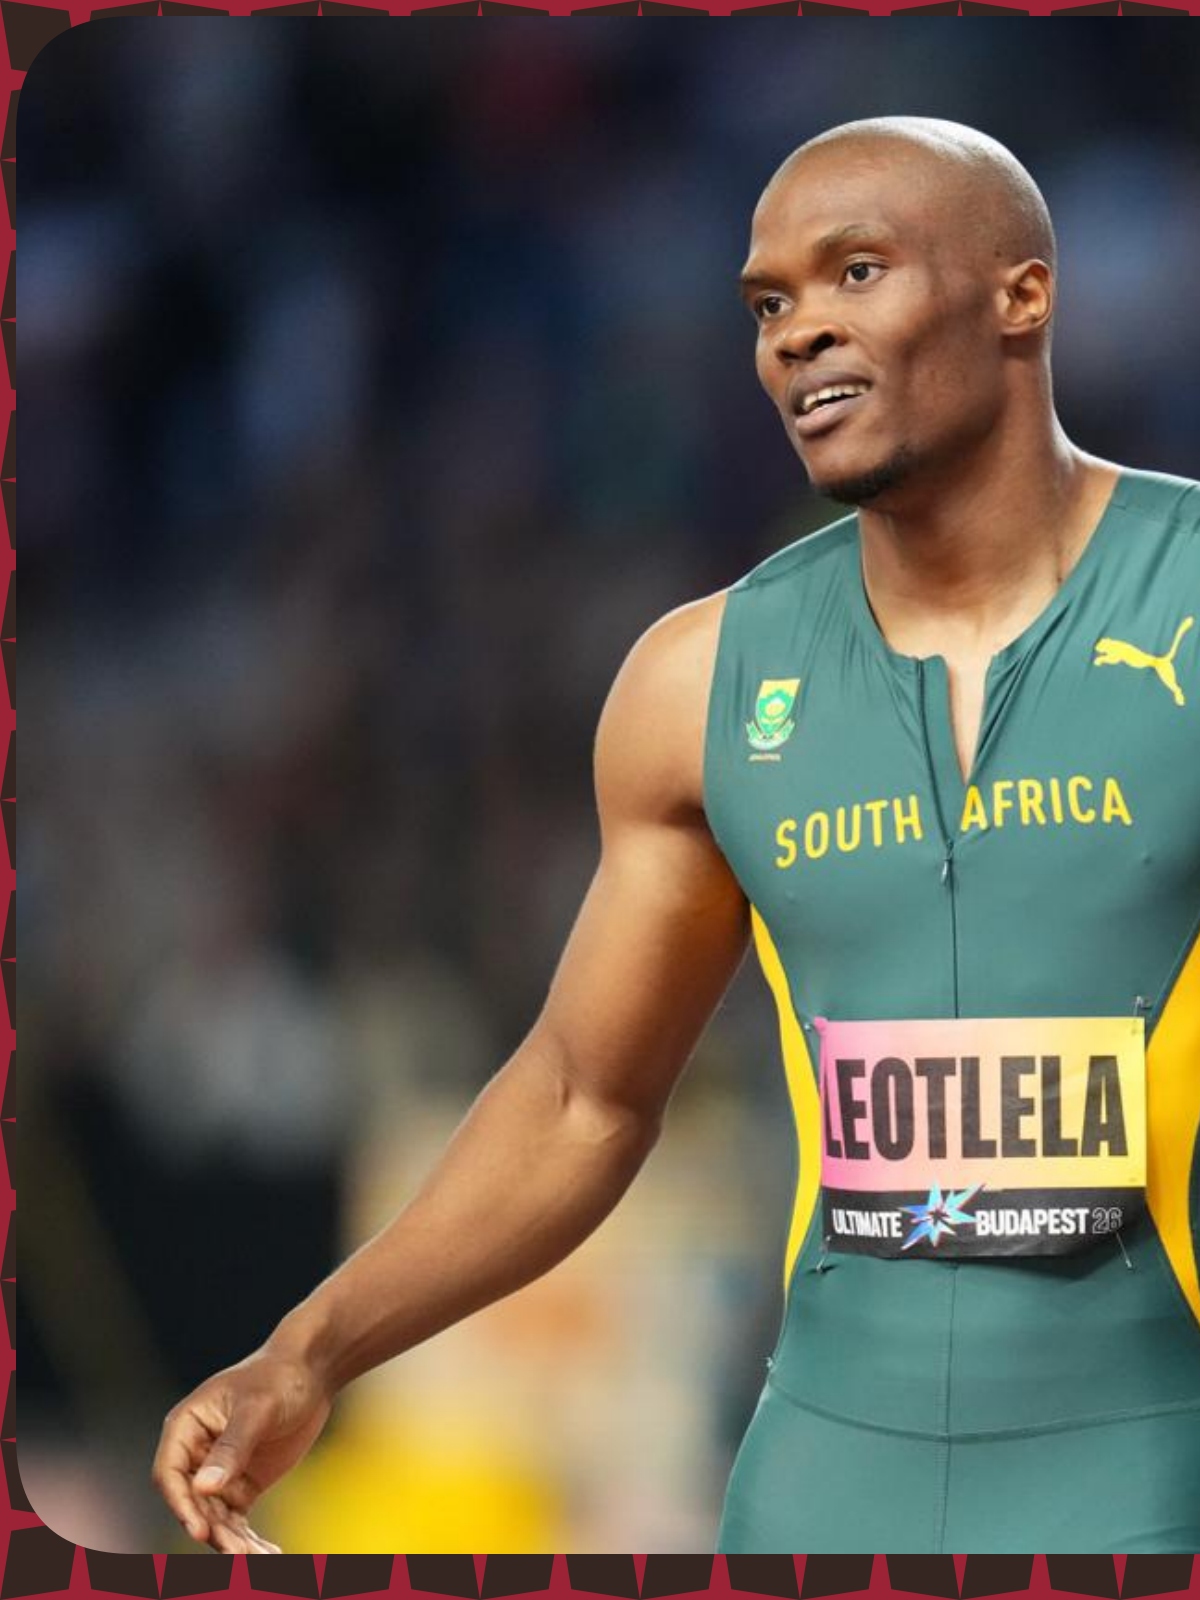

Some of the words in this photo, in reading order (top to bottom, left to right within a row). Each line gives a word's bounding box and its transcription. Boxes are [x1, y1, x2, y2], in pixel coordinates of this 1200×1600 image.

[775, 794, 923, 869] SOUTH
[960, 775, 1133, 832] AFRICA
[825, 1055, 1129, 1161] LEOTLELA
[832, 1208, 902, 1238] ULTIMATE
[976, 1208, 1089, 1236] BUDAPEST
[1091, 1207, 1123, 1234] 26
